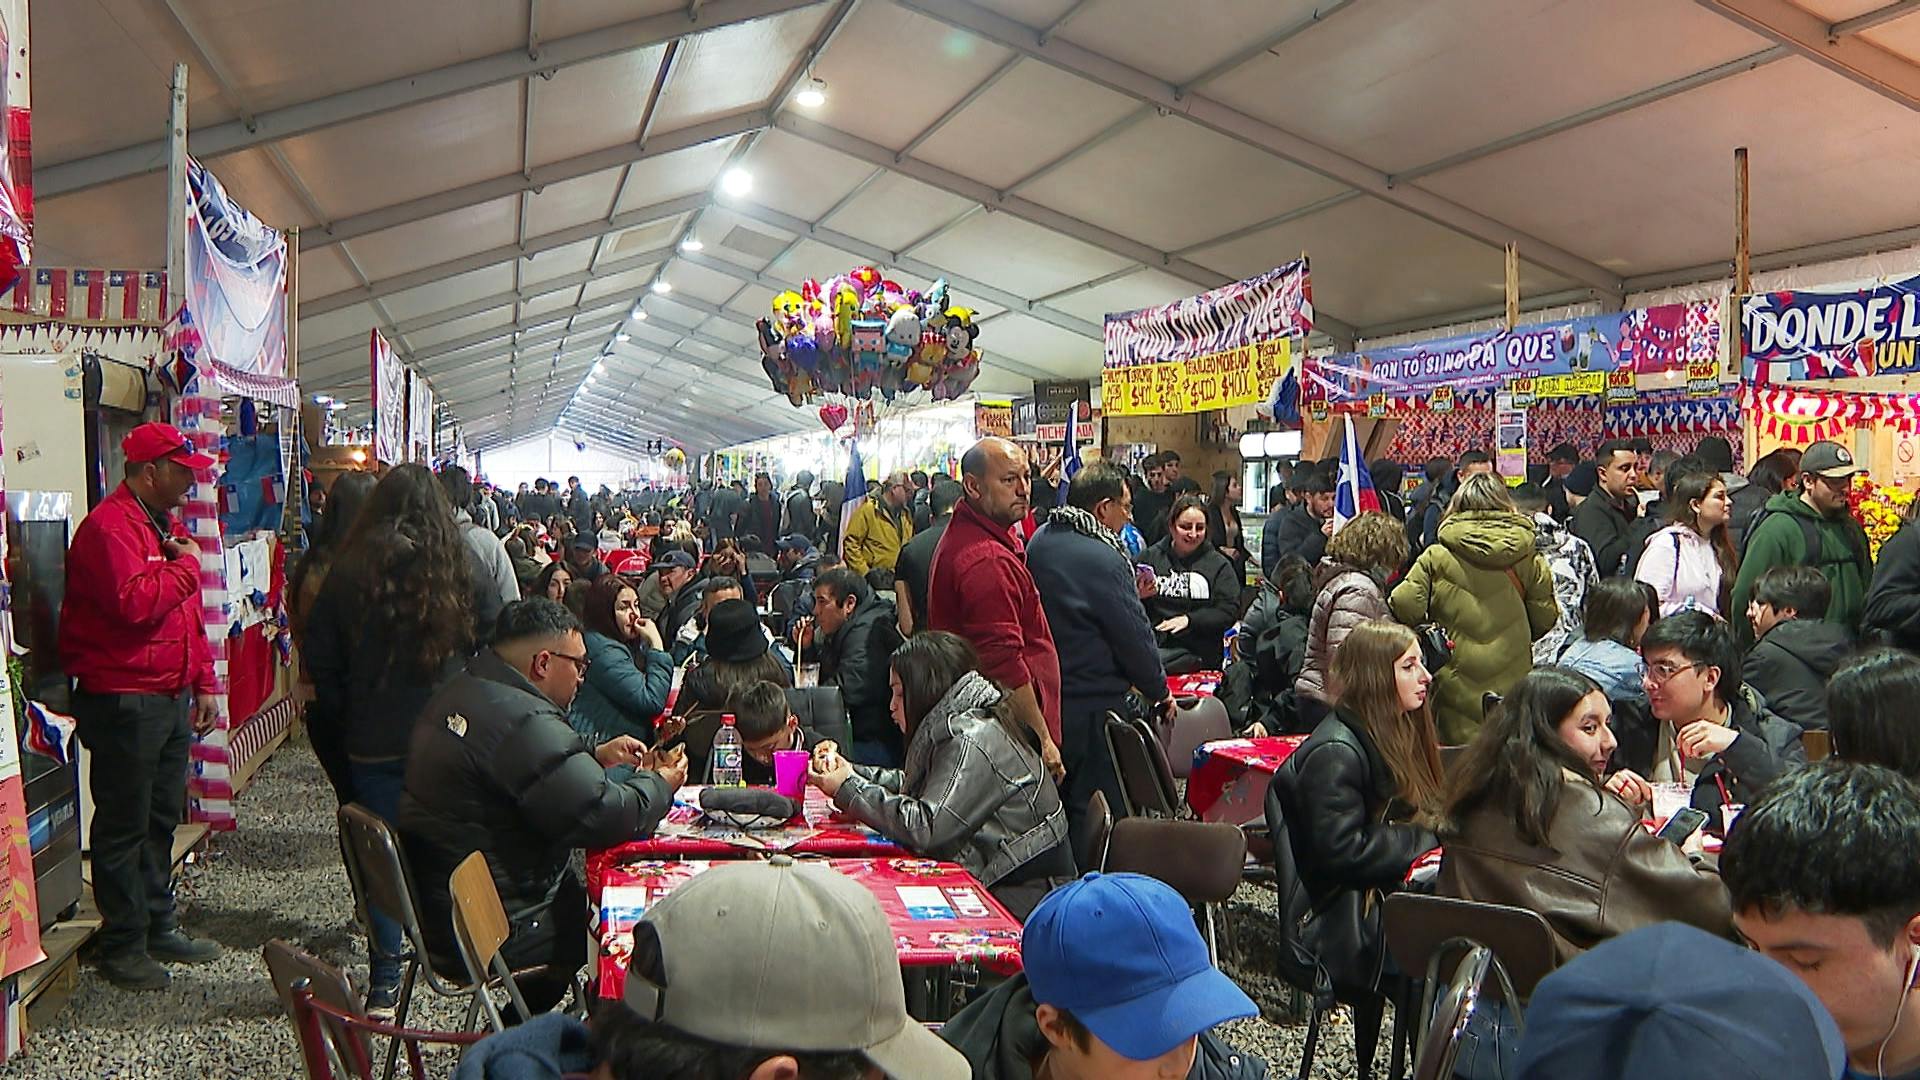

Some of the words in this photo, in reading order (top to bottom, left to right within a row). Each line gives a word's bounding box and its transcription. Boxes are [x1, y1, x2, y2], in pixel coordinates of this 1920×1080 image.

[1751, 296, 1891, 352] DONDE
[1373, 361, 1398, 380] CON
[1425, 354, 1440, 374] SI
[1444, 350, 1465, 373] NO
[1506, 333, 1556, 368] QUE
[1878, 340, 1915, 369] UN
